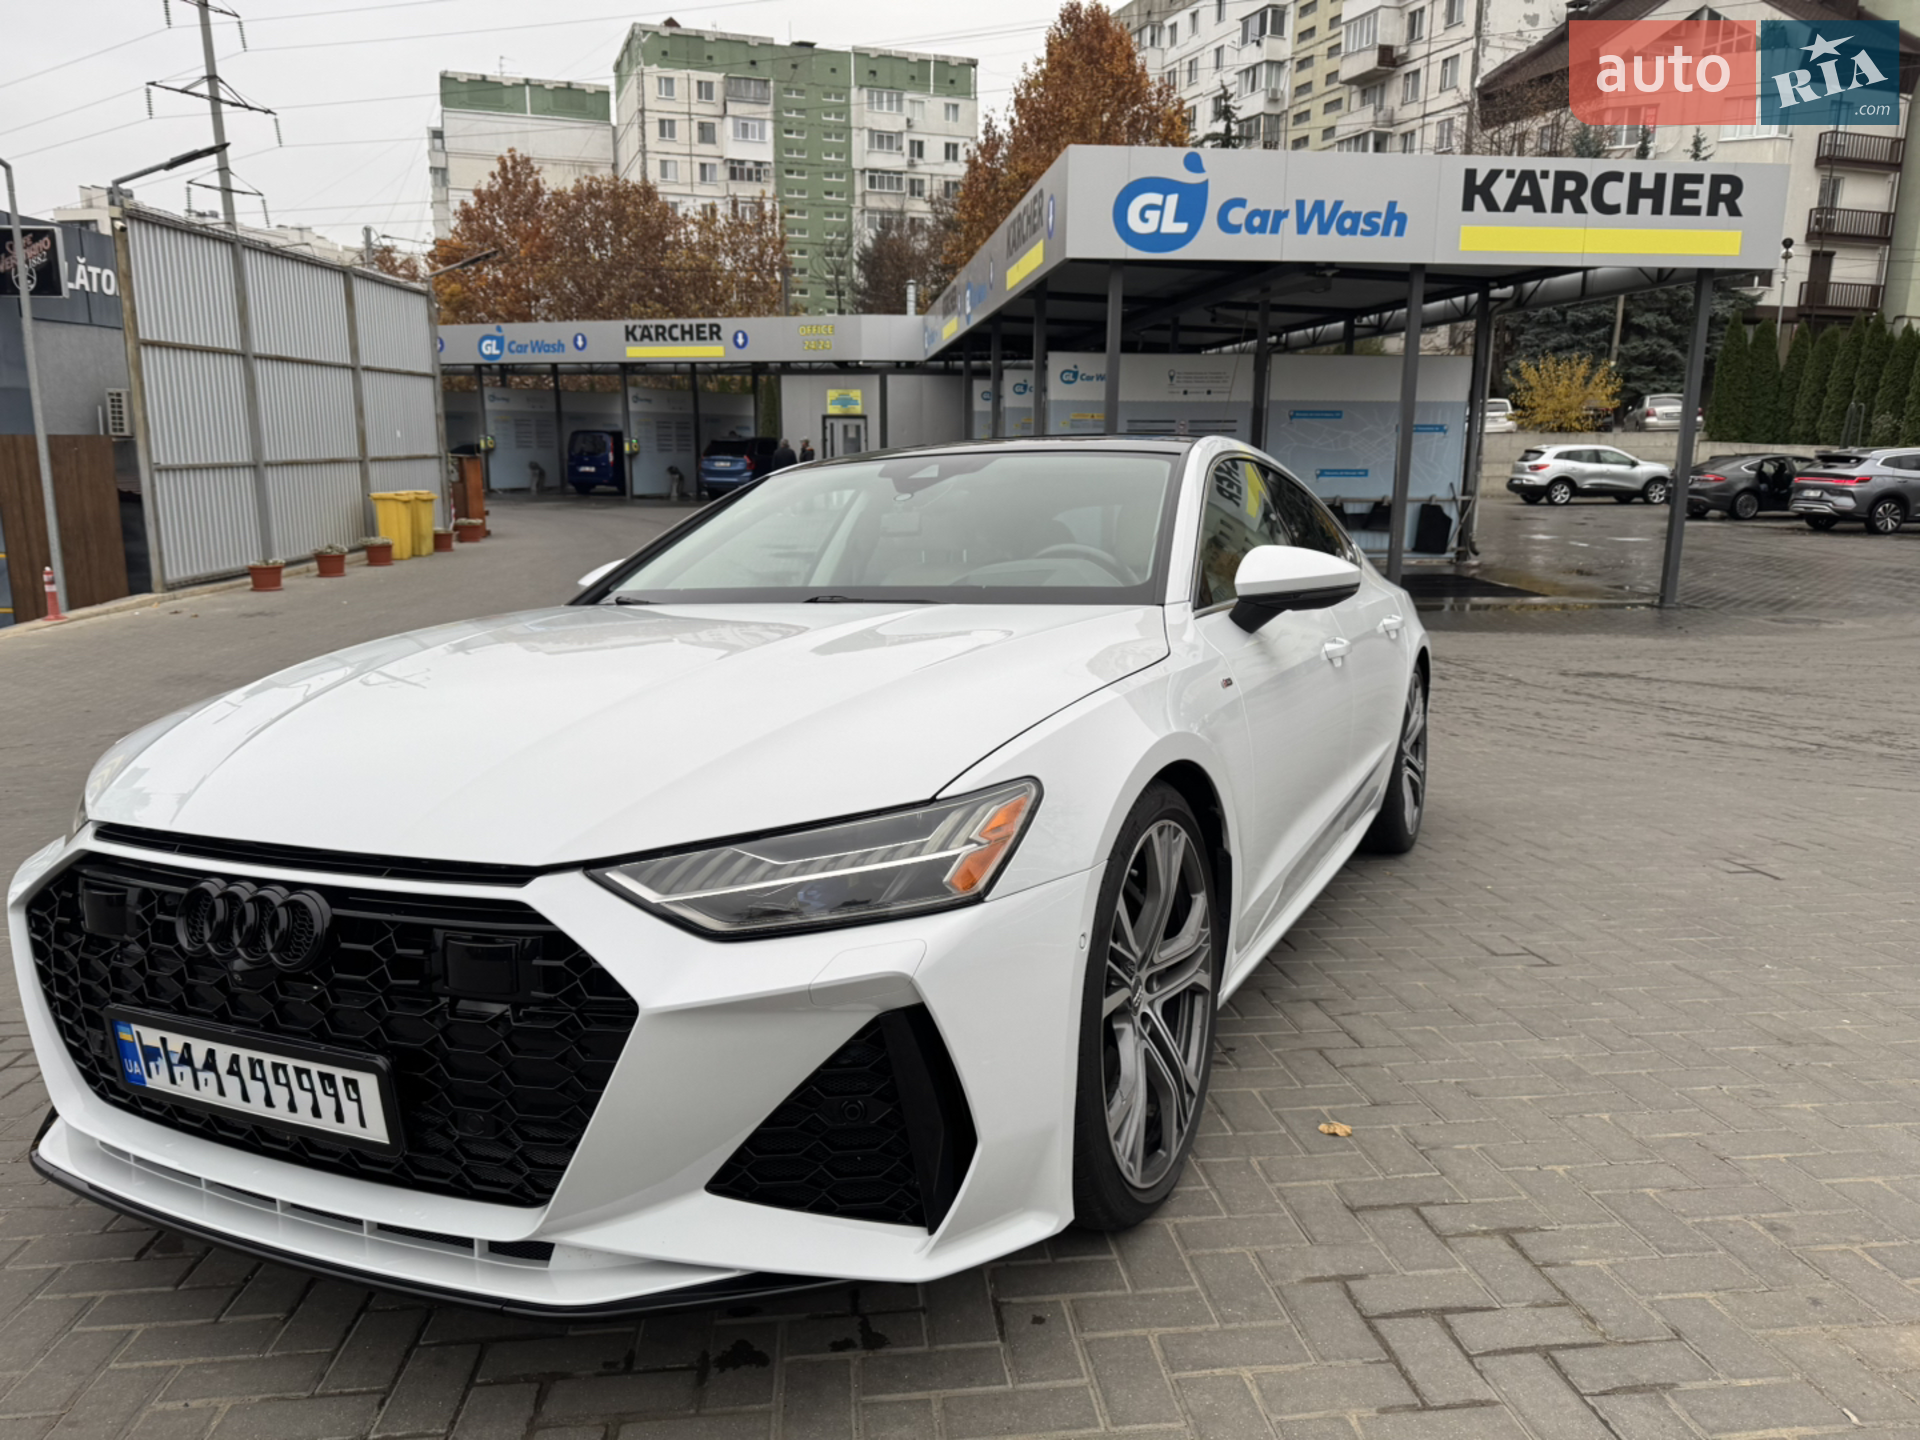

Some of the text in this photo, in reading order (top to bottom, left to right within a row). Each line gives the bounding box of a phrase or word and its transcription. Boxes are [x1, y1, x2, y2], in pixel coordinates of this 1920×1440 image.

[1461, 168, 1744, 217] KÄRCHER
[1127, 192, 1408, 238] GL Car Wash
[65, 255, 119, 296] LĂTO
[624, 323, 723, 342] KÄRCHER
[798, 324, 836, 336] OFFICE
[481, 339, 566, 355] GL Car Wash
[124, 1058, 142, 1076] UA
